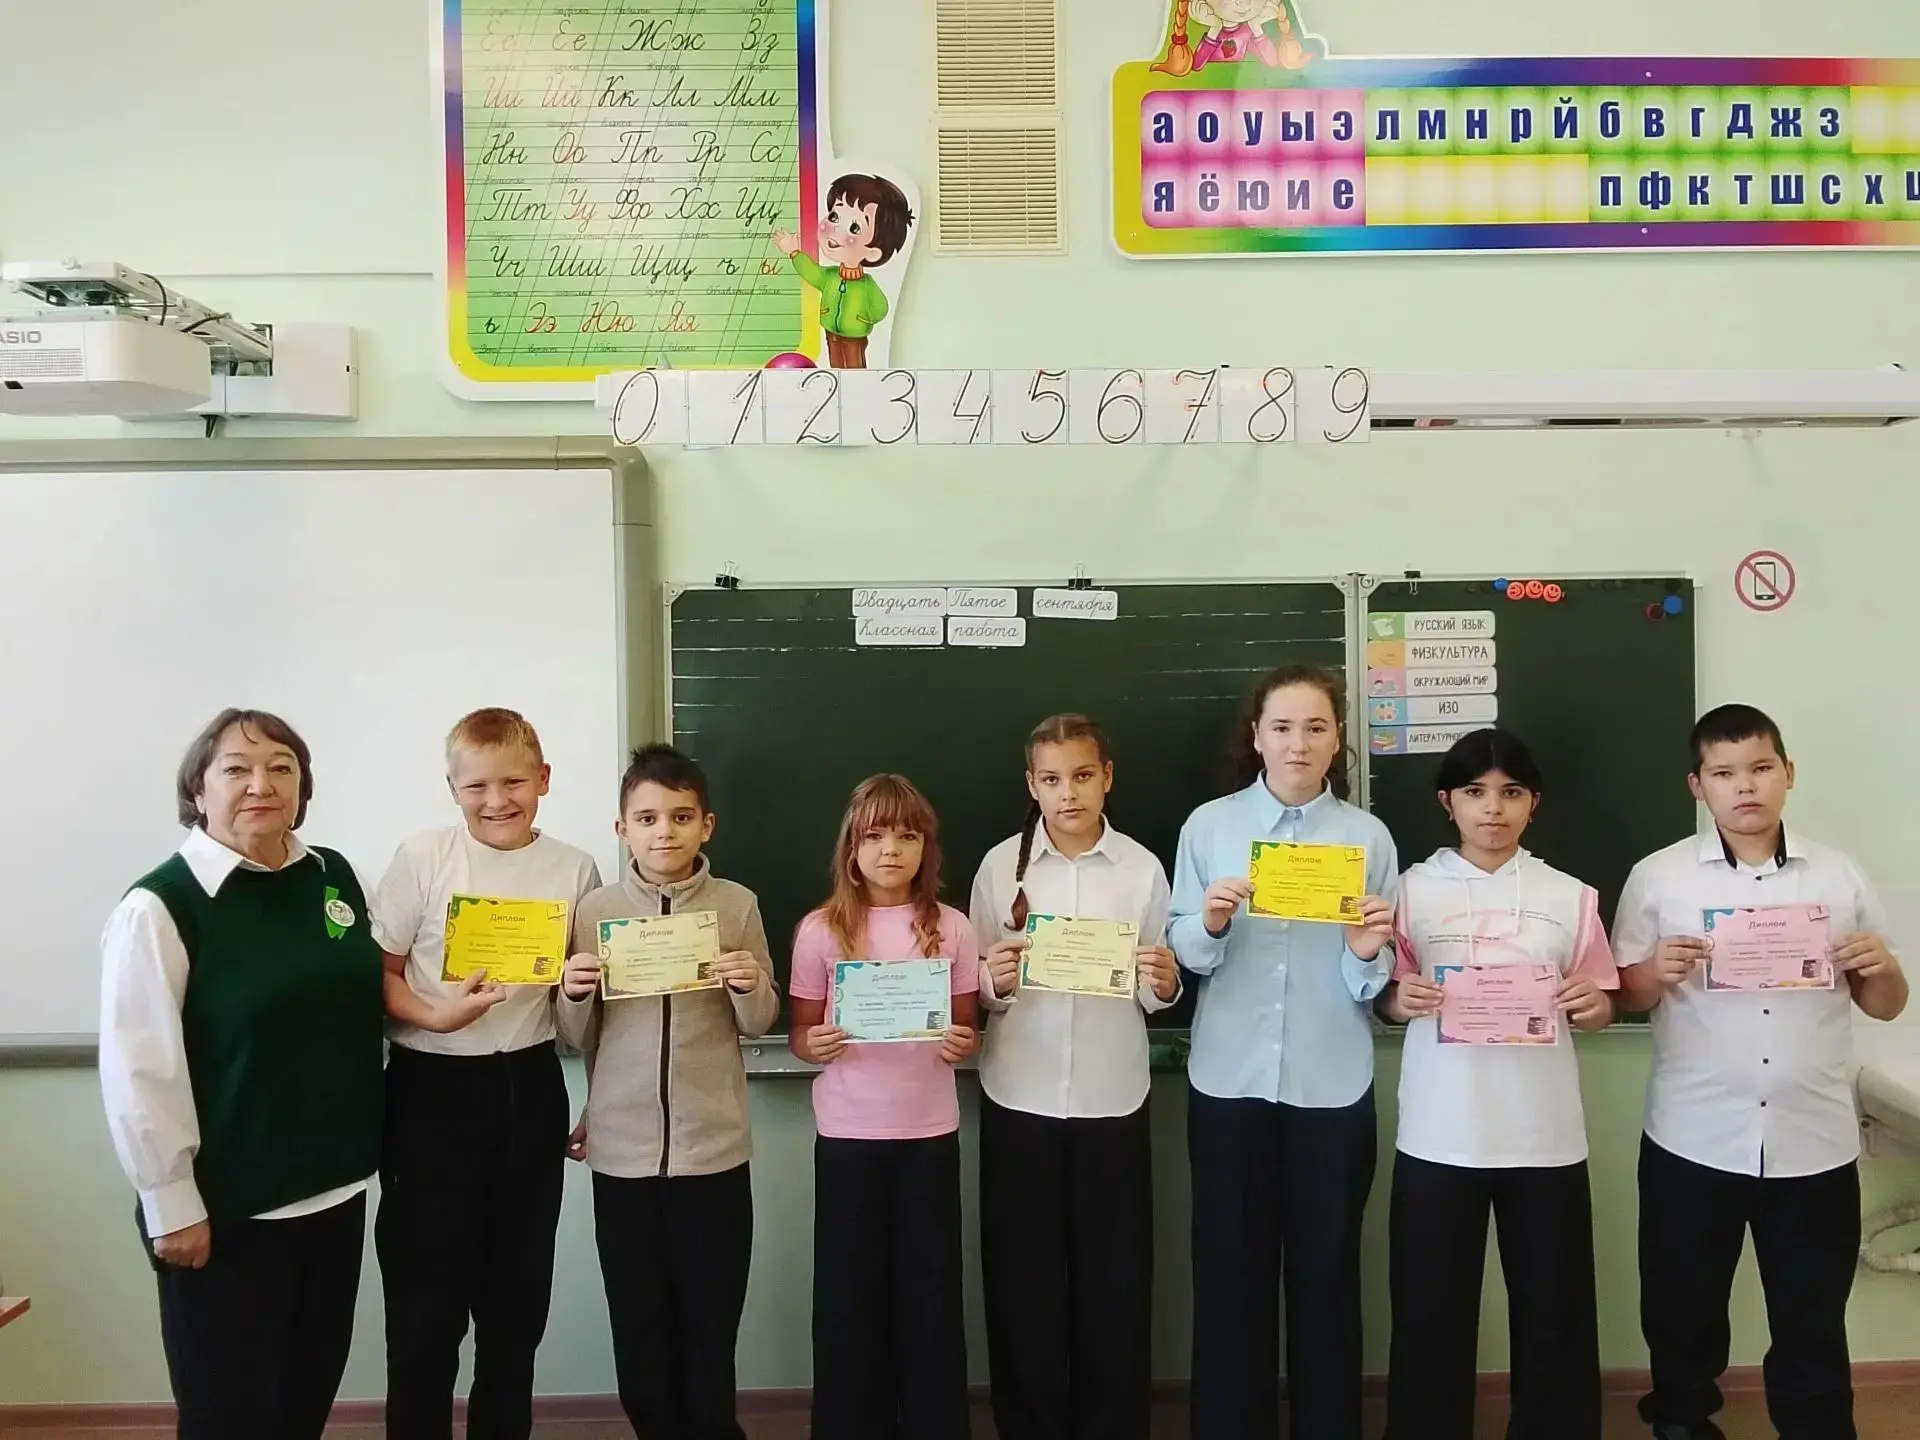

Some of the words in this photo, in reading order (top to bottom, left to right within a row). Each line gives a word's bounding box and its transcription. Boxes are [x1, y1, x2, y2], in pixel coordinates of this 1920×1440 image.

[622, 19, 705, 51] Жж
[741, 18, 779, 63] Зз
[598, 75, 639, 108] Кк
[652, 75, 701, 107] Лл
[714, 75, 780, 107] Мм
[1153, 112, 1174, 143] а
[1198, 112, 1219, 143] о
[1243, 111, 1264, 146] у
[1282, 111, 1315, 142] ы
[1333, 110, 1354, 141] э
[1376, 110, 1400, 141] л
[1418, 109, 1446, 140] м
[1466, 109, 1488, 140] н
[1511, 107, 1532, 143] р
[1554, 97, 1578, 138] й
[1600, 101, 1621, 138] б
[1644, 108, 1665, 138] в
[1691, 107, 1705, 138] г
[1771, 108, 1802, 138] ж
[1819, 107, 1840, 138] з
[483, 132, 528, 164] Нн
[553, 132, 588, 164] Оо
[611, 131, 663, 164] Пп
[686, 131, 726, 186] Рр
[750, 131, 782, 163] Сс
[1153, 181, 1175, 212] я
[1199, 173, 1220, 212] ё
[1238, 179, 1270, 211] ю
[1287, 179, 1310, 211] и
[1333, 178, 1354, 211] е
[1600, 175, 1622, 206] п
[1639, 171, 1671, 210] ф
[1688, 175, 1710, 206] к
[1734, 175, 1753, 205] т
[1771, 174, 1804, 205] ш
[1821, 174, 1841, 205] с
[1865, 174, 1884, 205] х
[483, 189, 552, 221] Тт
[564, 188, 597, 233] Уу
[608, 189, 653, 232] Фф
[665, 187, 721, 219] Хх
[736, 187, 782, 227] Цц
[490, 245, 525, 277] Чч
[548, 245, 607, 277] Шш
[631, 244, 697, 284] Щщ
[717, 258, 740, 276] ъ
[761, 258, 783, 275] ы
[484, 317, 501, 334] ь
[525, 301, 558, 334] Ээ
[581, 301, 636, 333] Юю
[658, 300, 700, 332] Яя
[613, 371, 659, 445] 0
[731, 369, 763, 444] 1
[796, 370, 840, 444] 2
[871, 370, 916, 444] 3
[953, 369, 990, 444] 4
[1021, 369, 1066, 443] 5
[1097, 369, 1143, 444] 6
[1176, 369, 1217, 443] 7
[1248, 367, 1294, 442] 8
[1323, 367, 1368, 442] 9
[854, 589, 941, 616] Двадцать
[949, 589, 1007, 609] Пятое
[1036, 592, 1114, 618] сентября
[858, 617, 937, 637] Классная
[951, 619, 1019, 643] работа
[1414, 617, 1456, 631] РУССКИЙ
[1461, 618, 1486, 630] ЯЗЫК
[1411, 645, 1488, 660] ФИЗКУЛЬТУРА
[1413, 674, 1471, 687] ОКРУЖАЮЩИЙ
[1472, 675, 1489, 686] МИР
[1438, 701, 1459, 714] ИЗО
[1287, 854, 1322, 864] Диплом
[489, 913, 526, 923] Диплом
[1062, 927, 1096, 937] Диплом
